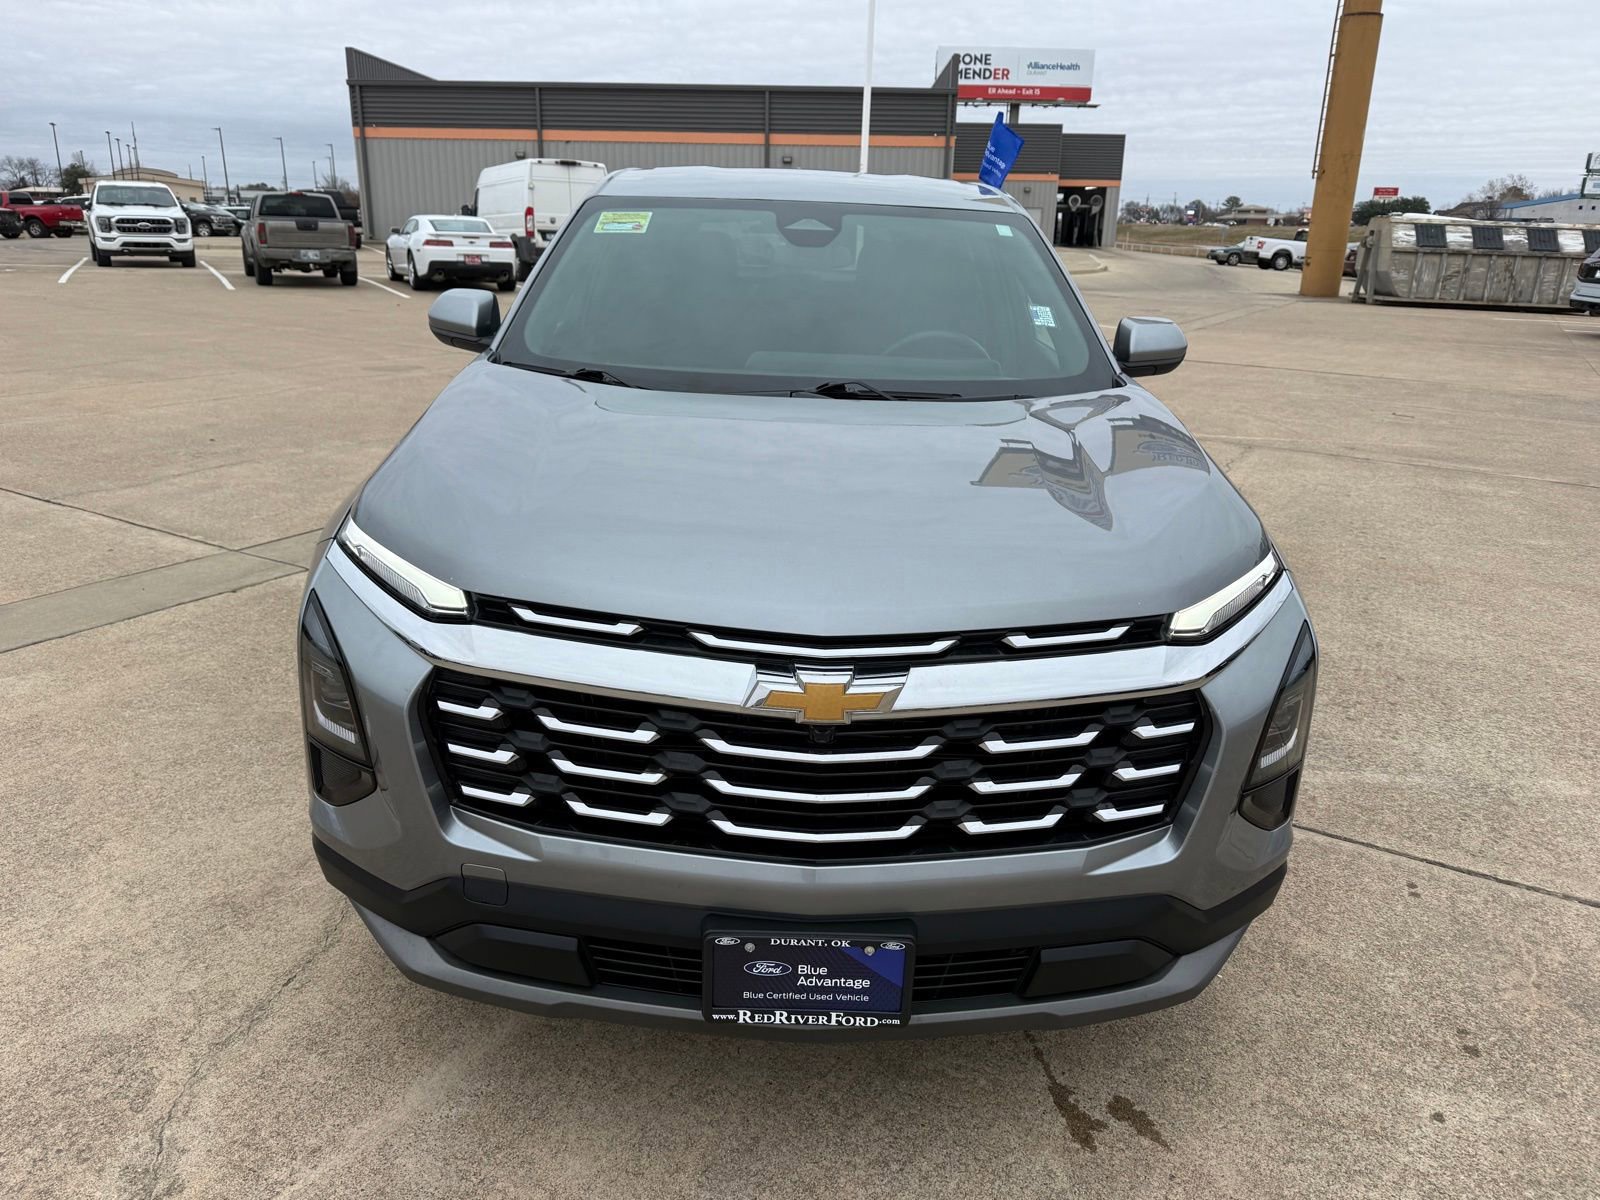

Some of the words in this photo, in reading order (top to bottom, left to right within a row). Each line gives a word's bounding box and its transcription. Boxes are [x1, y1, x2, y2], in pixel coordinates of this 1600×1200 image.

[1027, 61, 1081, 71] AllianceHealth
[770, 938, 828, 947] DURANT,
[831, 940, 851, 948] OK
[752, 963, 783, 974] Ford
[798, 964, 828, 975] Blue
[797, 976, 871, 989] Advantage
[743, 991, 764, 999] Blue
[766, 991, 807, 1000] Certified
[809, 993, 833, 1001] Used
[835, 993, 870, 1002] Vehicle
